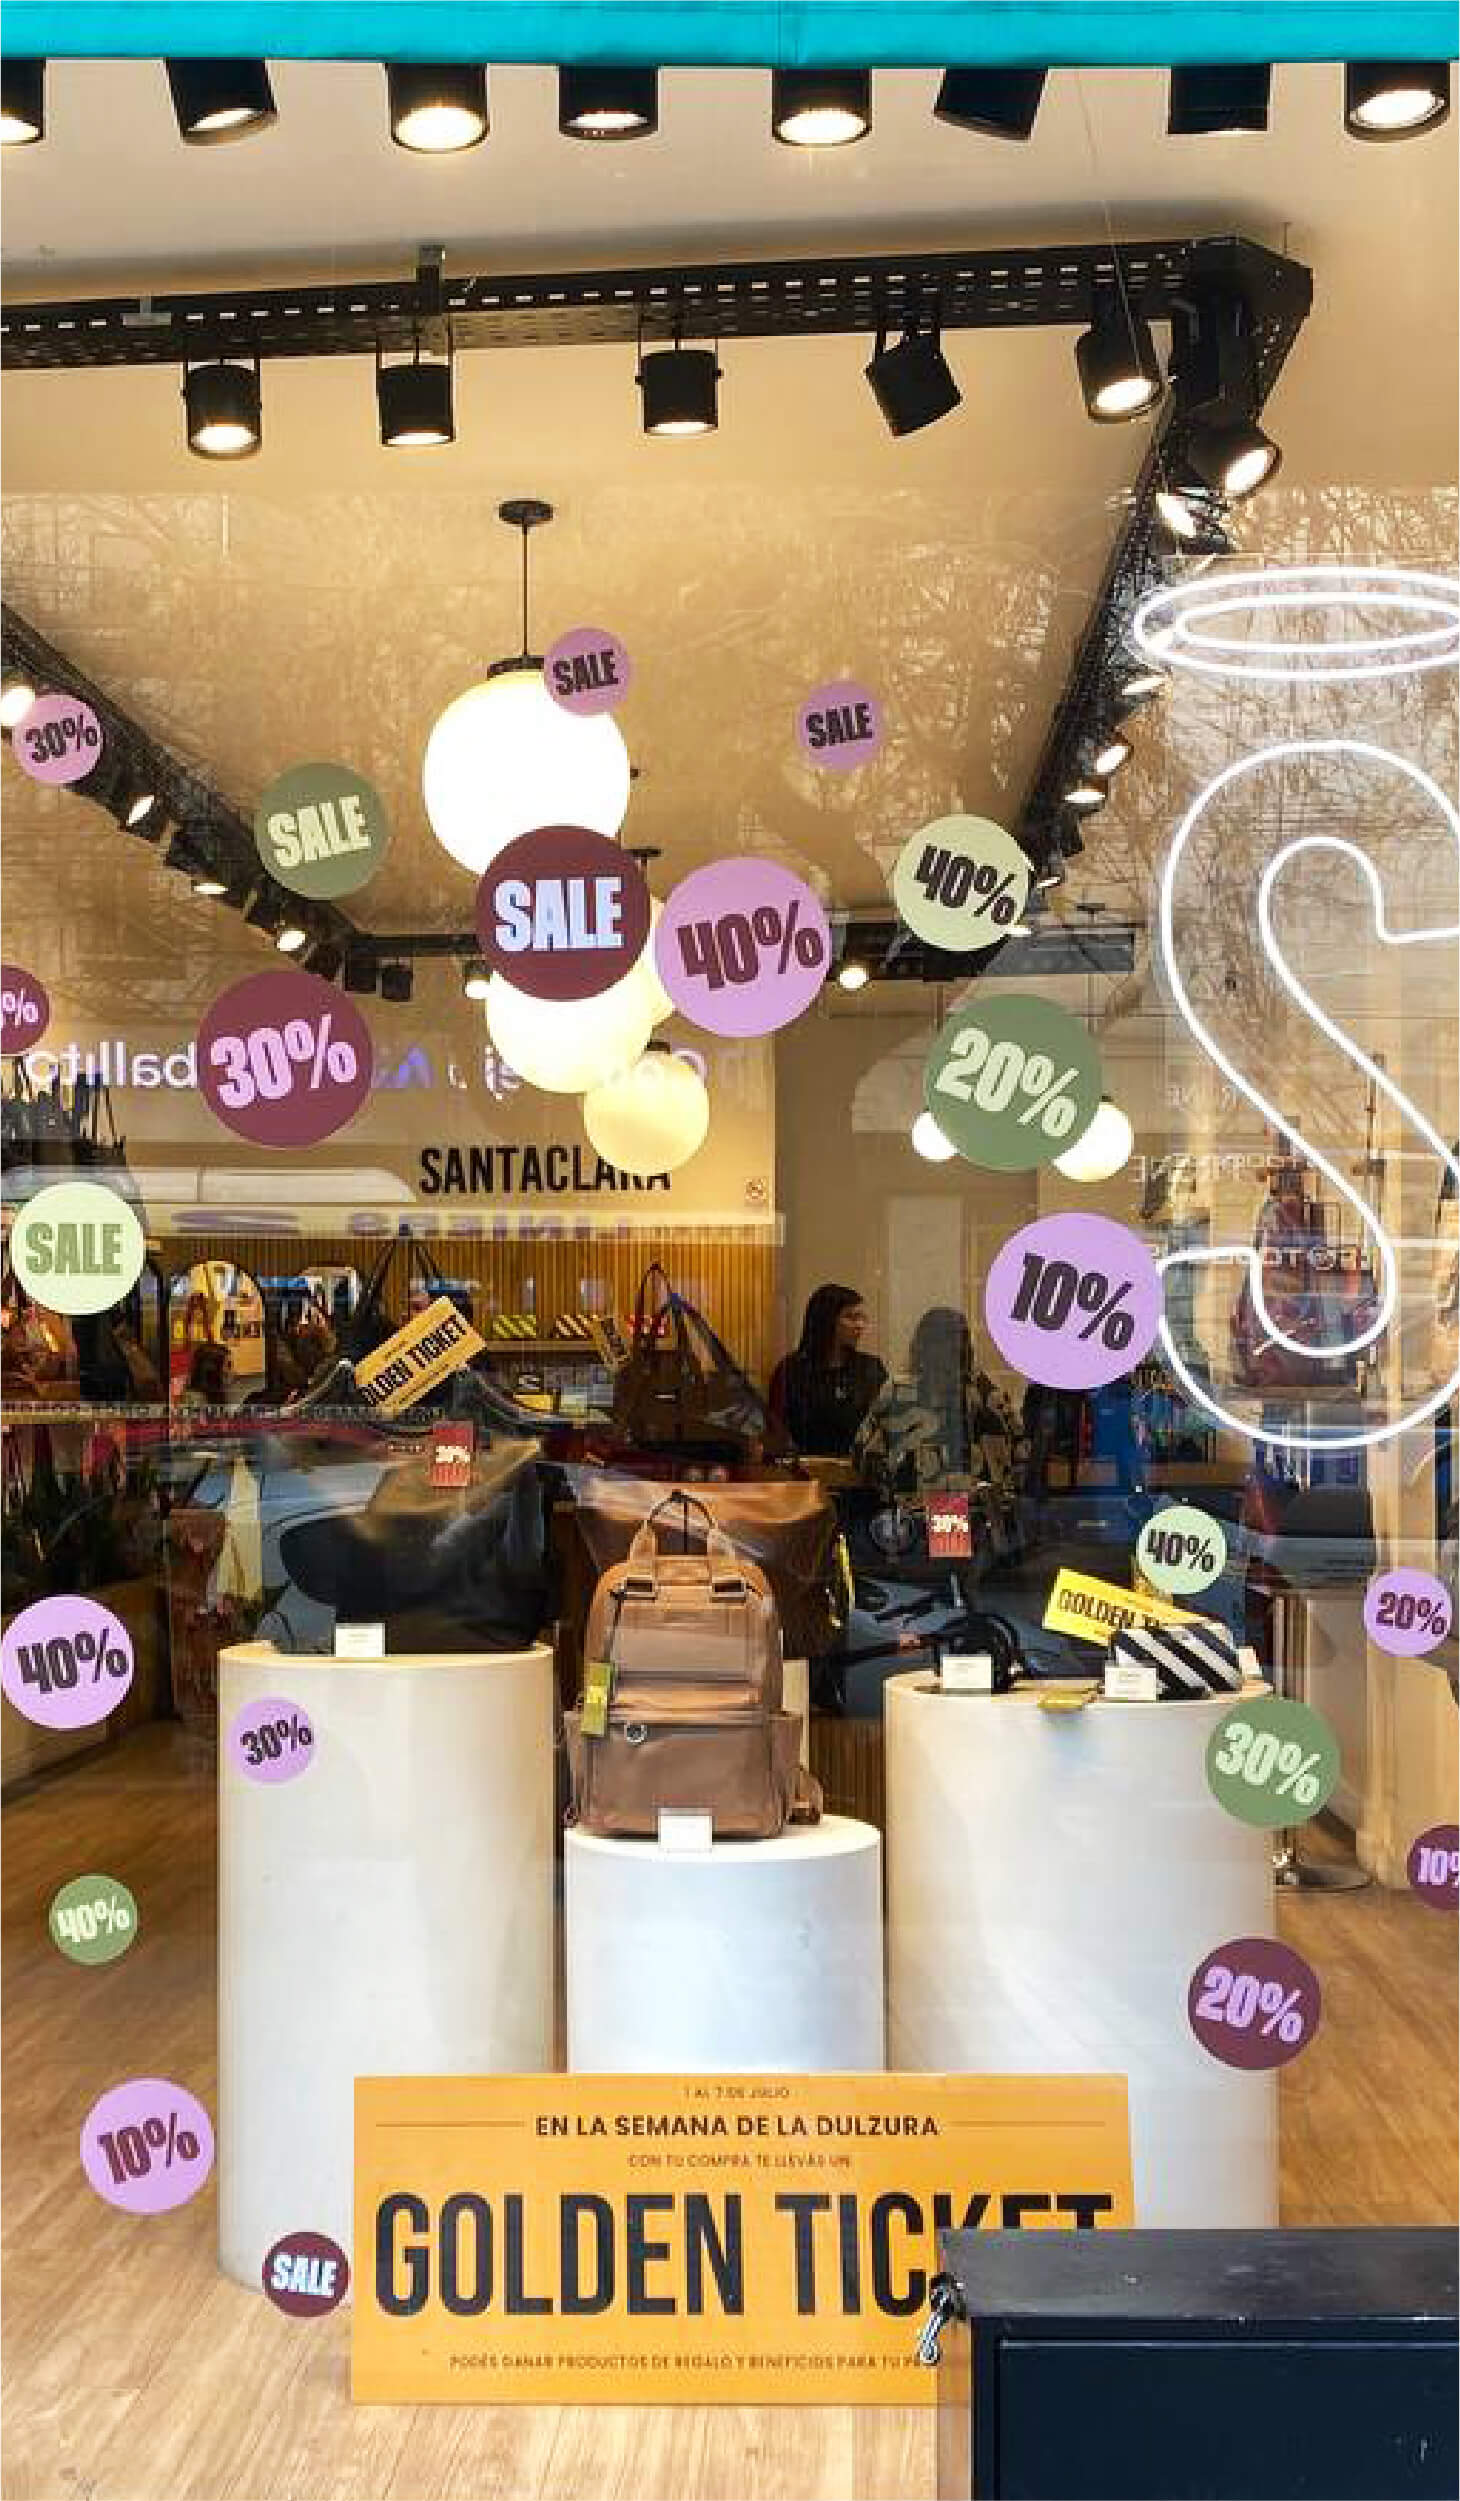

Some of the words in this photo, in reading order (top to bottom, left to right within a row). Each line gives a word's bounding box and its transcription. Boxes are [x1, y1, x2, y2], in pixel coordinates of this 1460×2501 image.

[553, 650, 618, 695] SALE
[26, 715, 98, 763] 30%
[806, 703, 872, 749] SALE
[268, 796, 371, 867] SALE
[915, 845, 1016, 926] 40%
[496, 877, 622, 952] SALE
[677, 900, 823, 991] 40%
[211, 1014, 356, 1108] 30%
[935, 1028, 1078, 1137] 20%
[26, 1223, 122, 1276] SALE
[1011, 1252, 1135, 1350] 10%
[405, 1315, 466, 1368] TICKET
[1145, 1528, 1214, 1572] 40%
[1059, 1588, 1136, 1630] GOLDEN
[1376, 1591, 1446, 1637] 20%
[18, 1628, 127, 1694] 40%
[240, 1714, 312, 1766] 30%
[1216, 1723, 1320, 1804] 30%
[57, 1896, 130, 1943] 40%
[1197, 1966, 1302, 2042] 20%
[97, 2113, 200, 2184] 10%
[535, 2114, 568, 2136] EN
[577, 2114, 607, 2136] LA
[614, 2114, 729, 2136] SEMANA
[737, 2114, 770, 2136] DE
[777, 2114, 807, 2136] LA
[817, 2114, 940, 2136] DULZURA
[628, 2154, 661, 2168] CON
[667, 2154, 684, 2168] TU
[687, 2154, 752, 2168] COMPRA
[271, 2254, 337, 2298] SALE
[375, 2191, 742, 2316] GOLDEN
[775, 2191, 1113, 2316] TIC
[558, 2354, 648, 2369] PRODUCTOS
[652, 2354, 669, 2369] DE
[748, 2354, 833, 2369] BENEFICIOS
[837, 2354, 877, 2369] PARA
